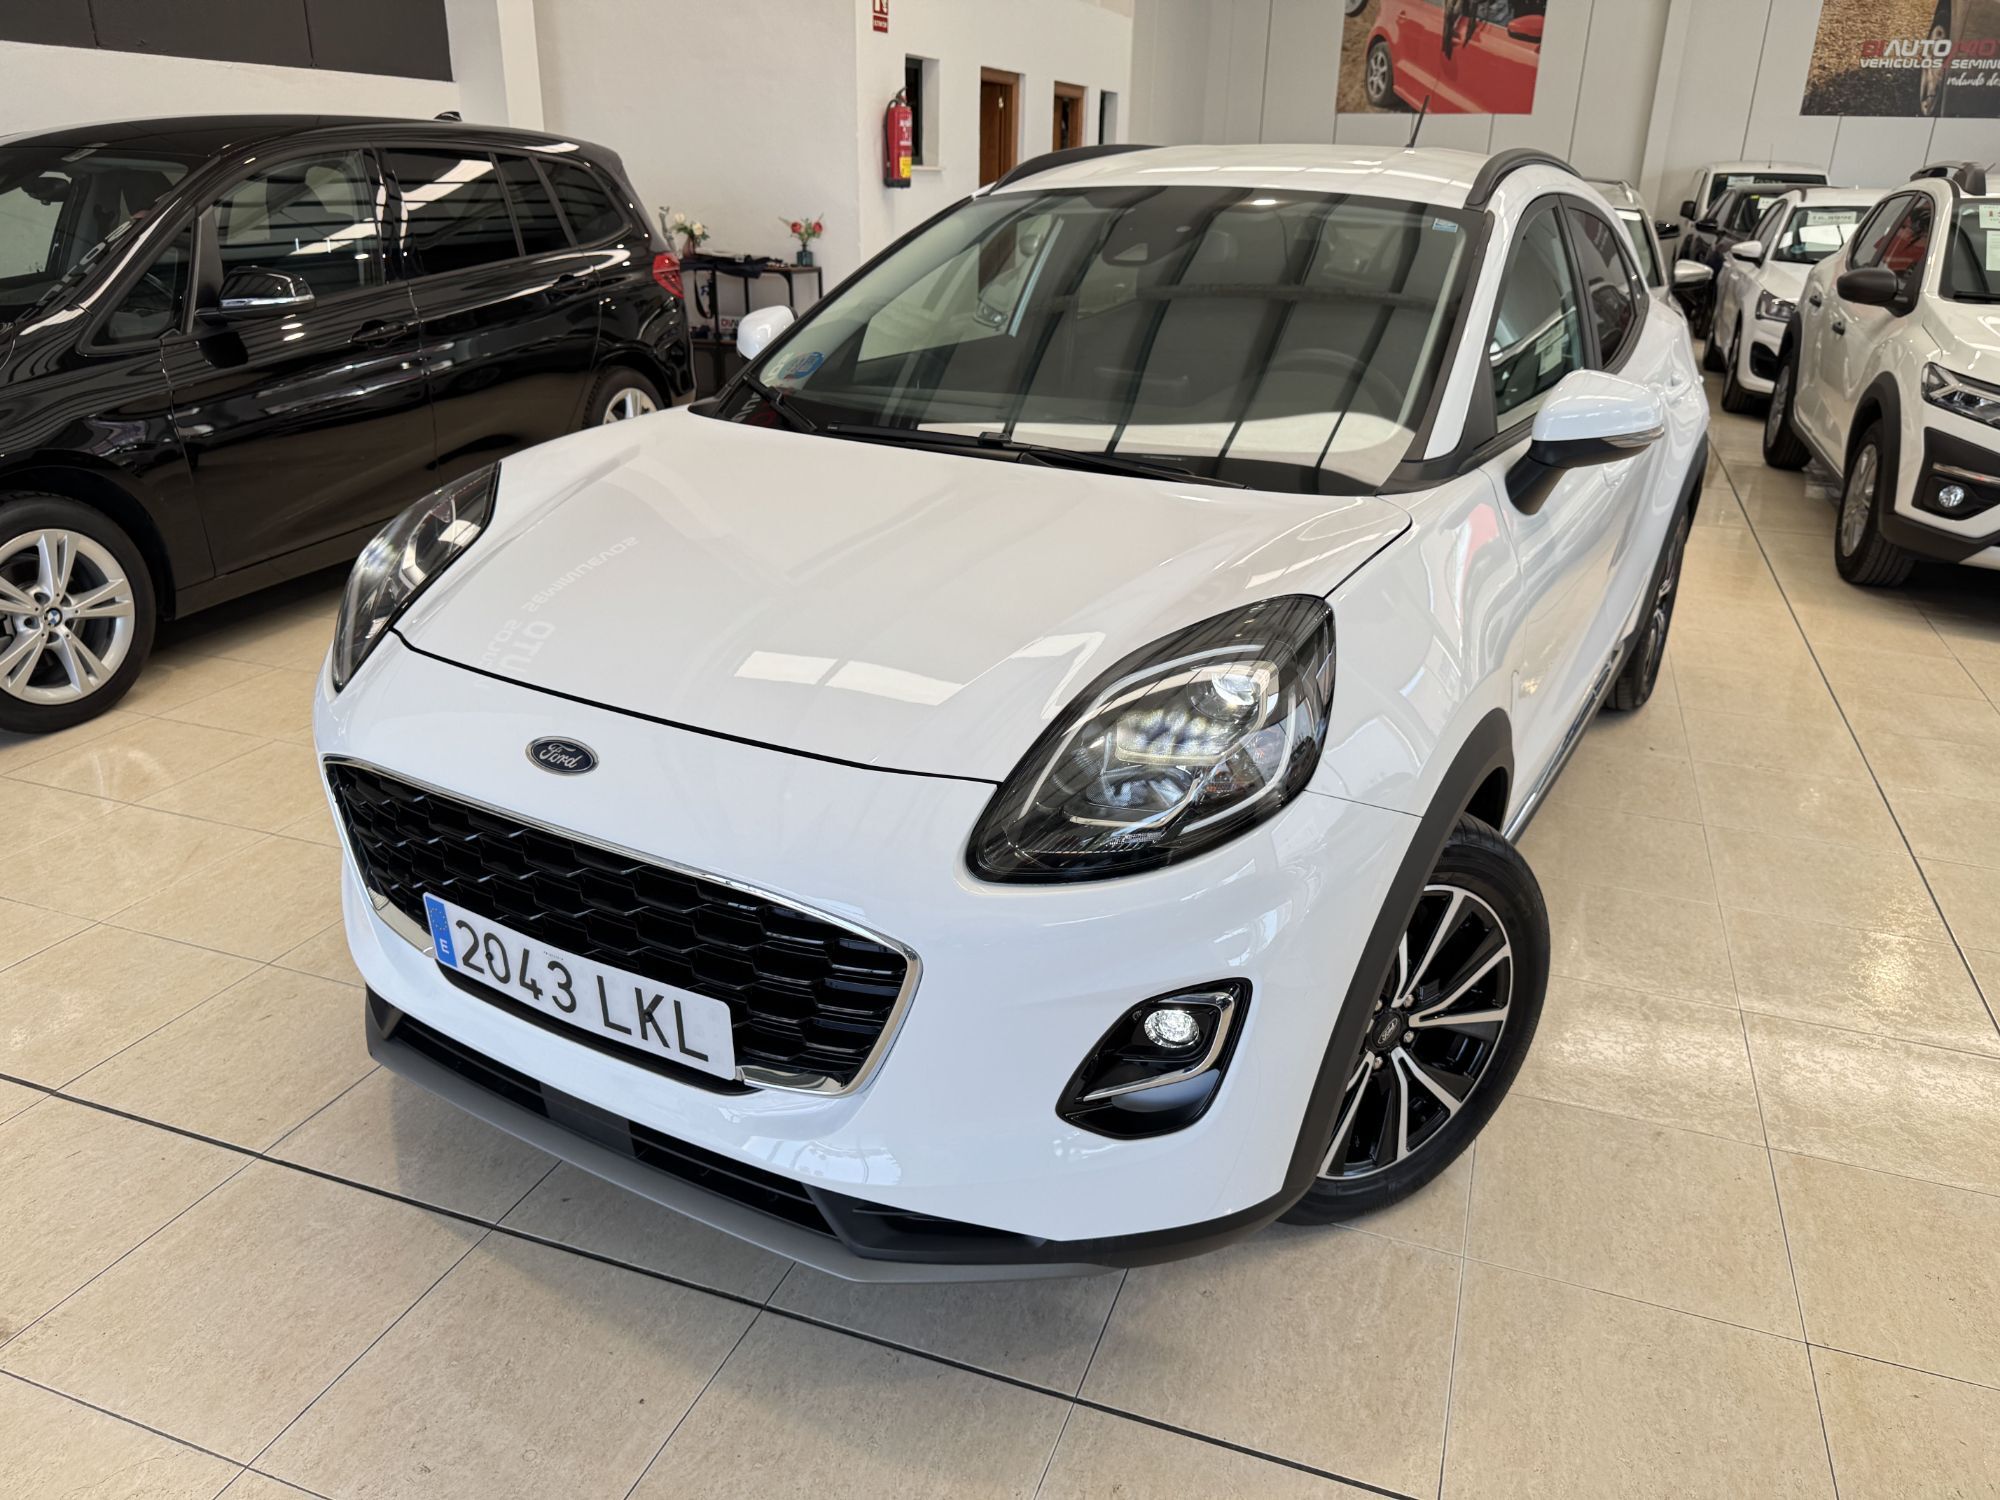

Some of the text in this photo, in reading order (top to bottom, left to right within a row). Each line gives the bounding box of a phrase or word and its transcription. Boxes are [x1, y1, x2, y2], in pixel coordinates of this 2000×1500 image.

[1860, 58, 1943, 69] VEHICULOS
[539, 742, 583, 769] Ford
[439, 937, 450, 955] E
[455, 919, 709, 1063] 2043 LKL
